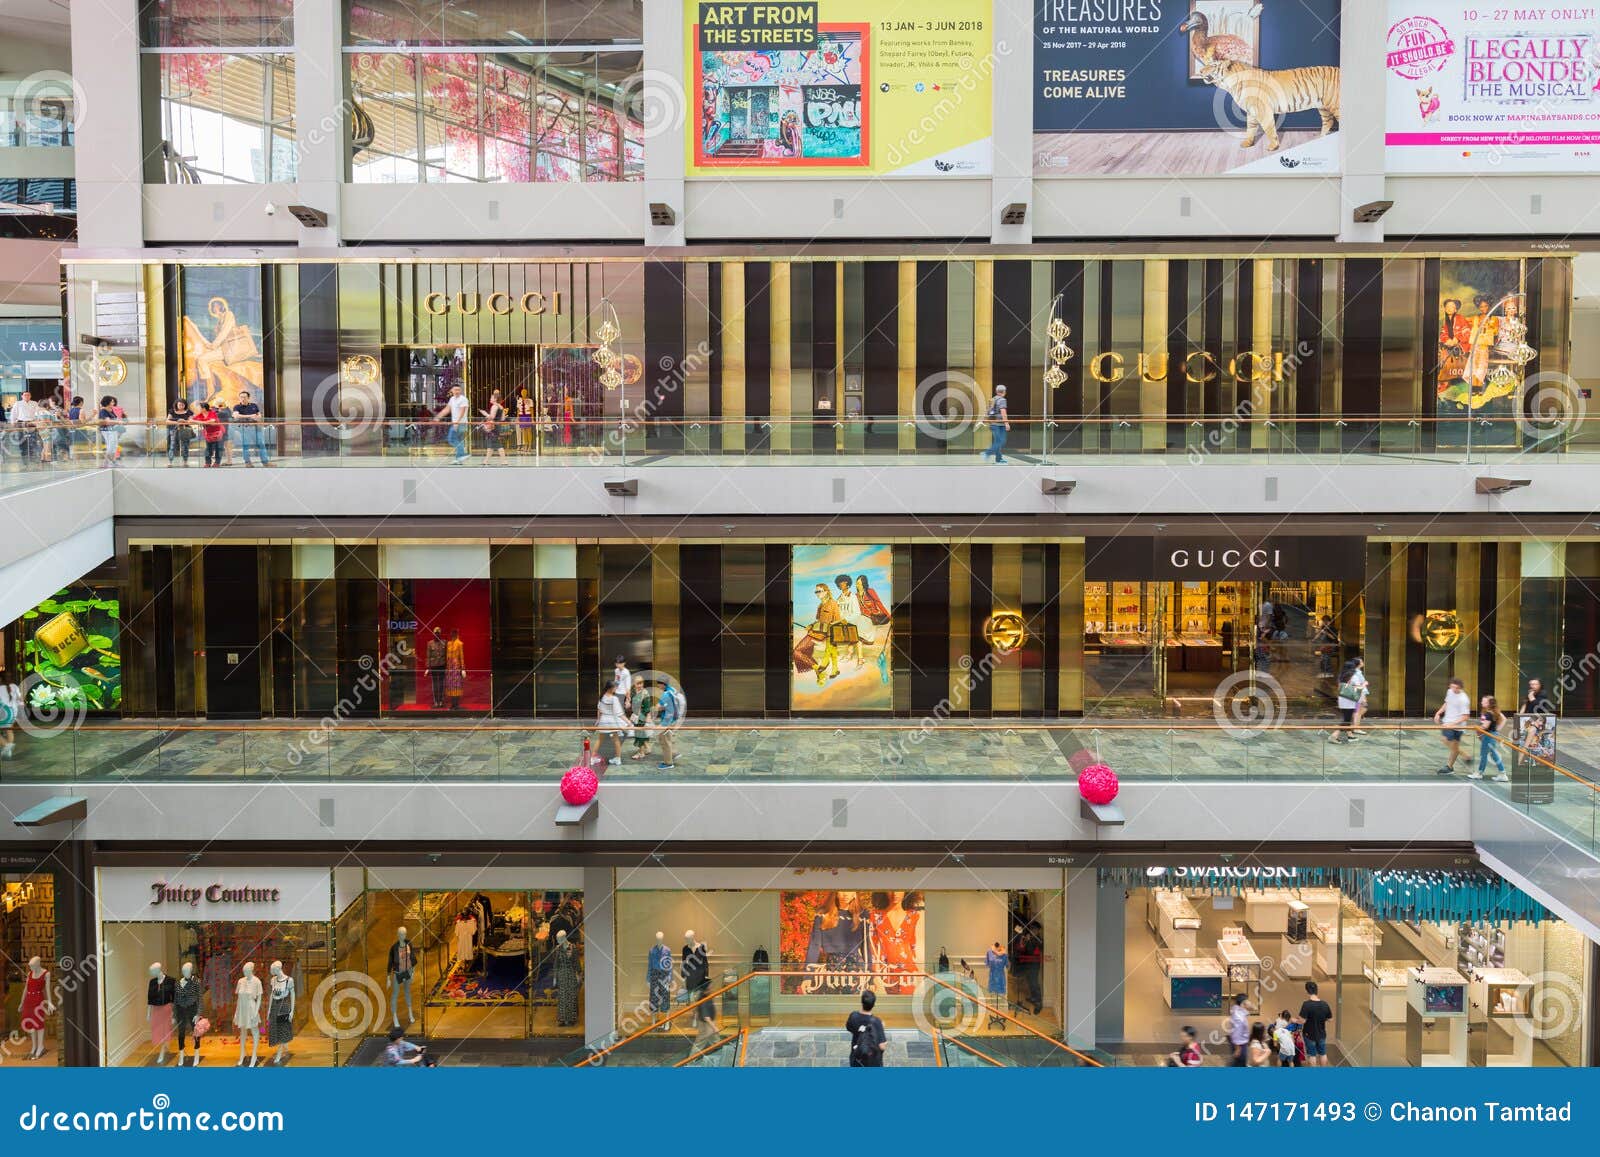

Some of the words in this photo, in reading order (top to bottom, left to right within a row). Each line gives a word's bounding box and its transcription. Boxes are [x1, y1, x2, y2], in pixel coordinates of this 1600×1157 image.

[703, 6, 748, 25] ART
[753, 6, 814, 25] FROM
[1043, 0, 1162, 21] TREASURES
[1463, 9, 1478, 21] 10
[1494, 9, 1509, 21] 27
[1514, 9, 1546, 21] MAY
[1551, 8, 1595, 20] ONLY!
[880, 21, 892, 31] 13
[894, 21, 915, 31] JAN
[926, 21, 933, 31] 3
[934, 21, 956, 31] JUN
[958, 21, 983, 31] 2018
[1042, 26, 1056, 34] OF
[1059, 26, 1078, 34] THE
[1080, 26, 1123, 34] NATURAL
[703, 29, 737, 43] THE
[740, 28, 815, 43] STREETS
[1405, 31, 1427, 47] FUN
[1097, 42, 1109, 50] Apr
[1469, 39, 1589, 59] LEGALLY
[1390, 54, 1401, 66] IT
[1043, 69, 1126, 82] TREASURES
[1468, 61, 1587, 82] BLONDE
[1043, 86, 1083, 98] COME
[1085, 86, 1126, 98] ALIVE
[1468, 83, 1503, 96] THE
[1509, 83, 1586, 96] MUSICAL
[1448, 114, 1472, 122] BOOK
[423, 291, 562, 315] GUCCI
[1089, 351, 1283, 382] GUCCI
[1170, 549, 1281, 568] GUCCI
[150, 883, 202, 907] Juicy
[204, 883, 281, 904] Couture
